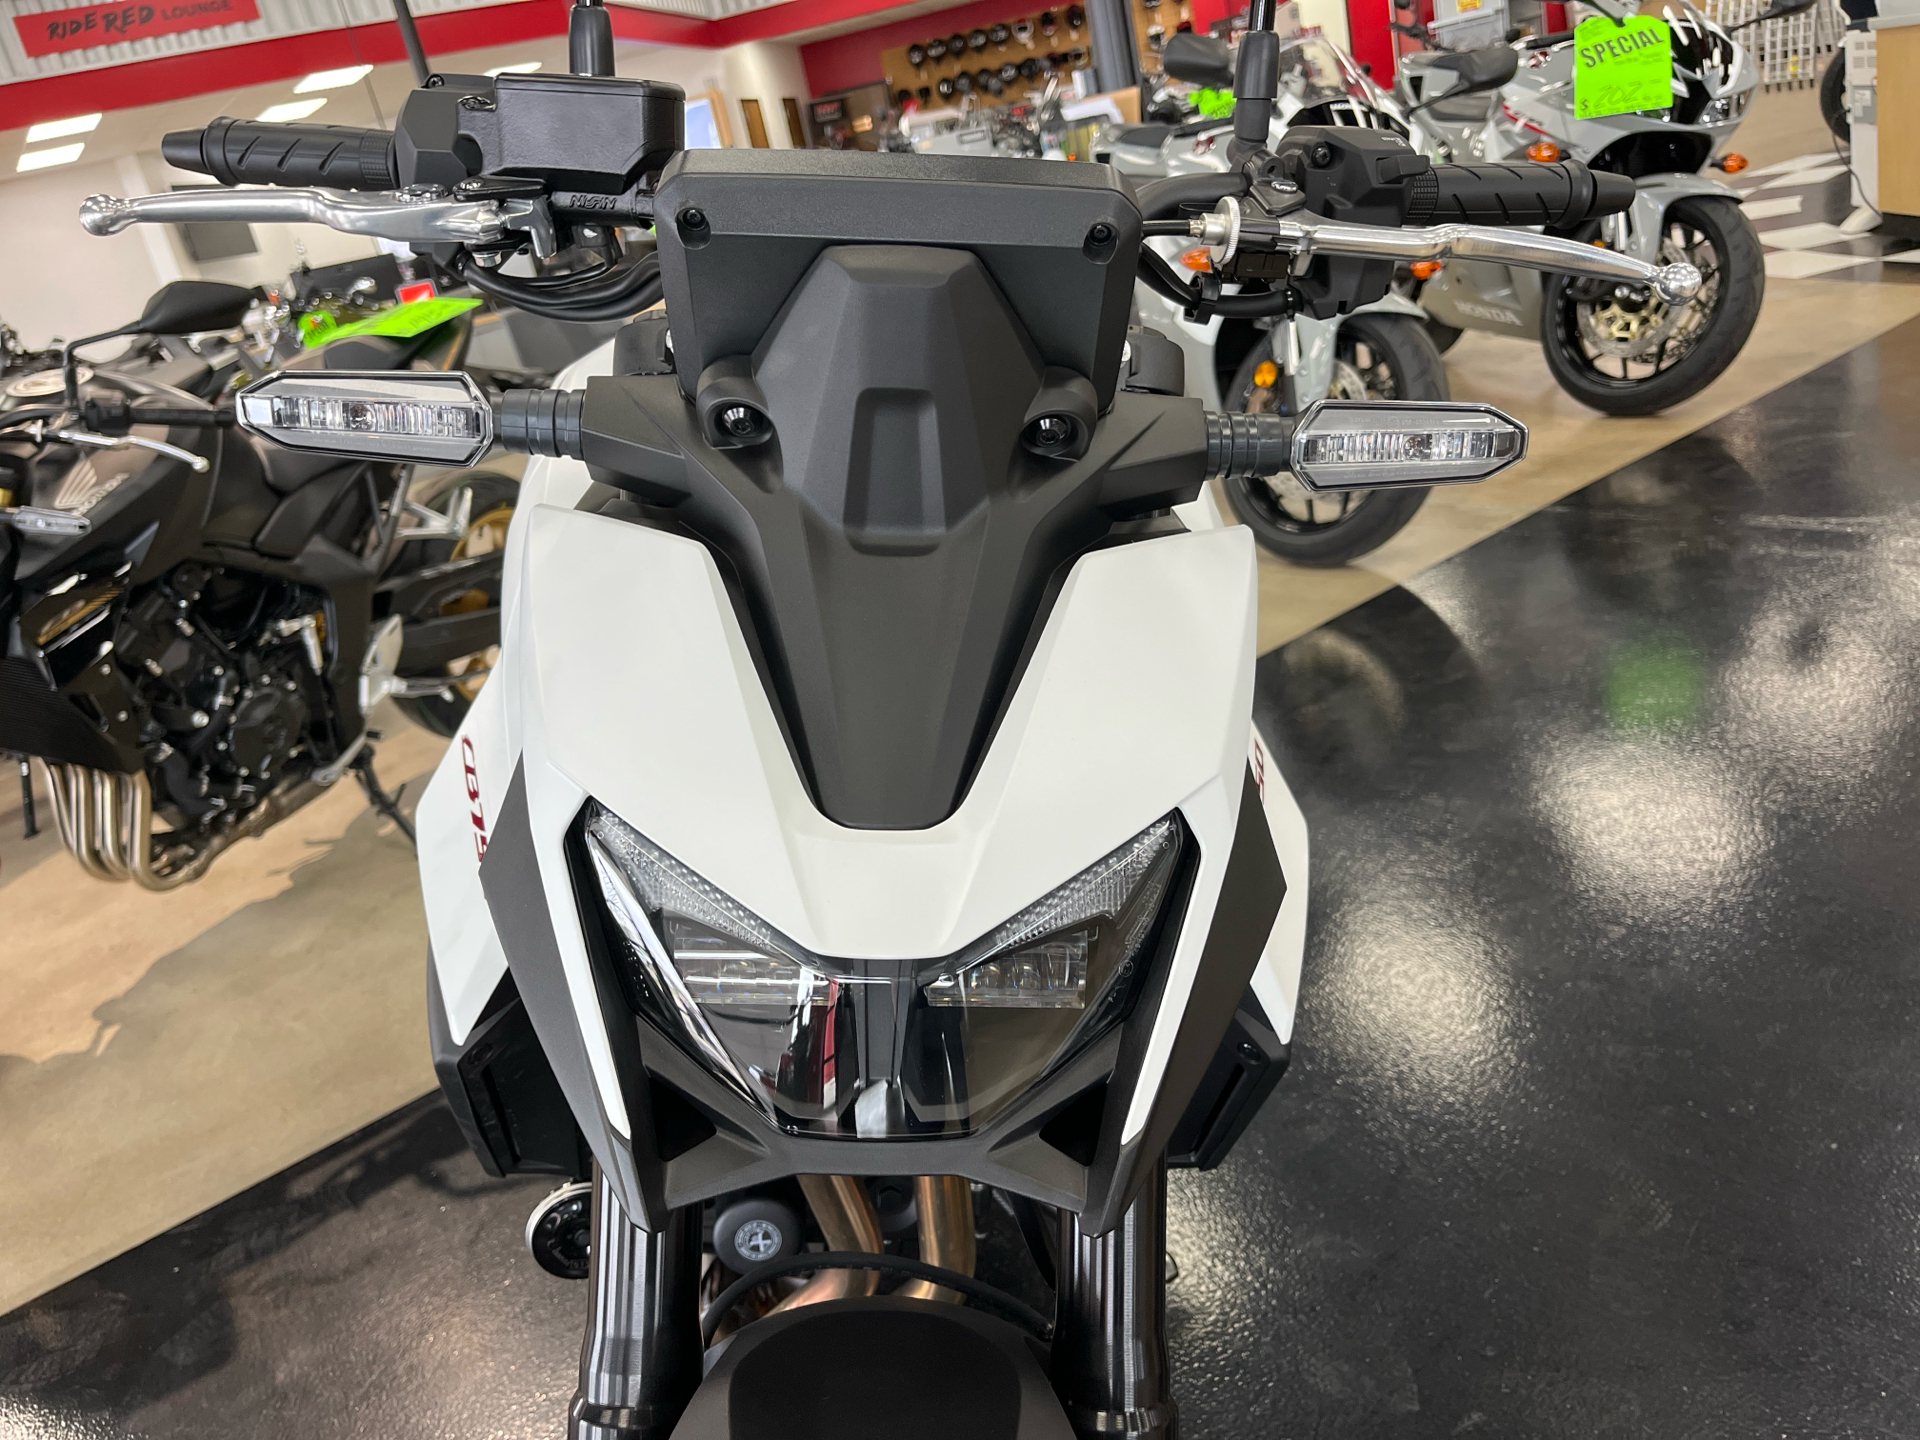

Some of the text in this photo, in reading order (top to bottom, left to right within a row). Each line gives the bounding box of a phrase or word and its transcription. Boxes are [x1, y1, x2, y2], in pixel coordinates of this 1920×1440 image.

[47, 0, 232, 41] RIDE RED LOUNGE
[1580, 28, 1664, 68] SPECIAL
[1454, 300, 1523, 327] HONDA
